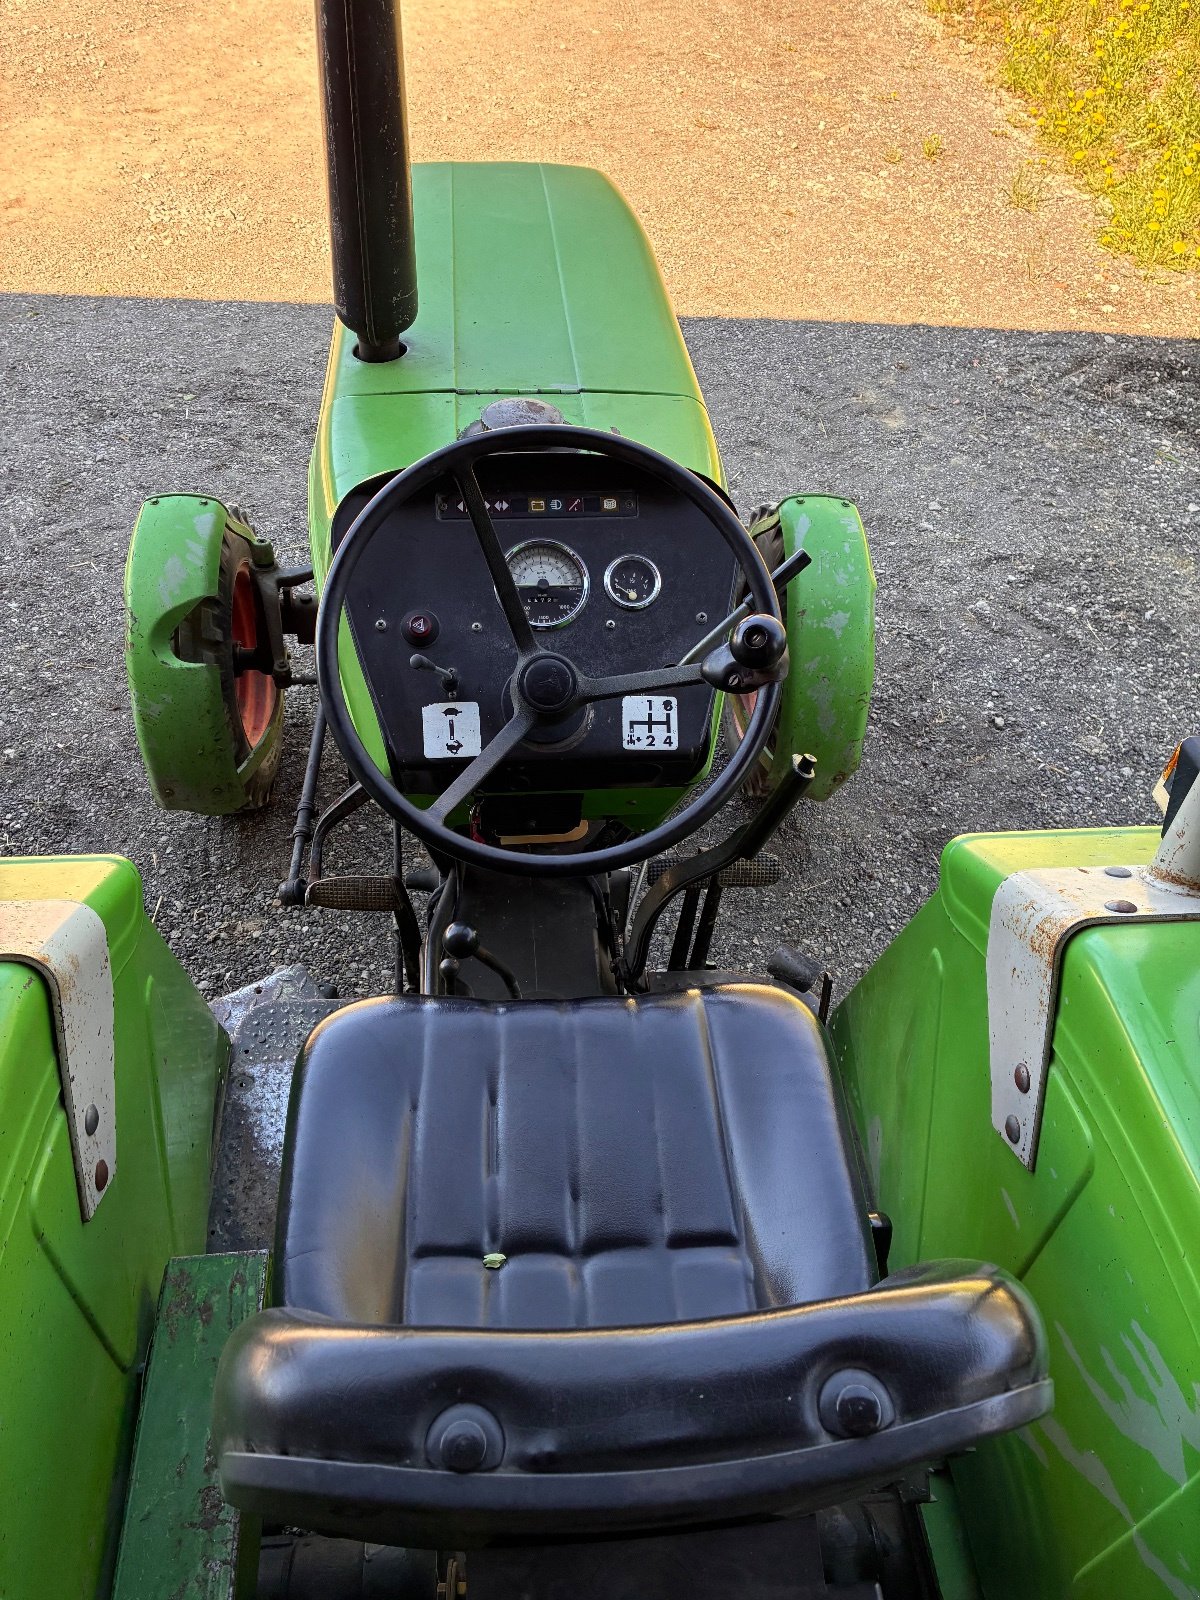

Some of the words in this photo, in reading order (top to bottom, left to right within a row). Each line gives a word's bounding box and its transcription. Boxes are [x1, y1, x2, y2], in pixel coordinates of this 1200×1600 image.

[647, 700, 652, 711] 1
[646, 735, 655, 746] 2
[663, 736, 673, 747] 4
